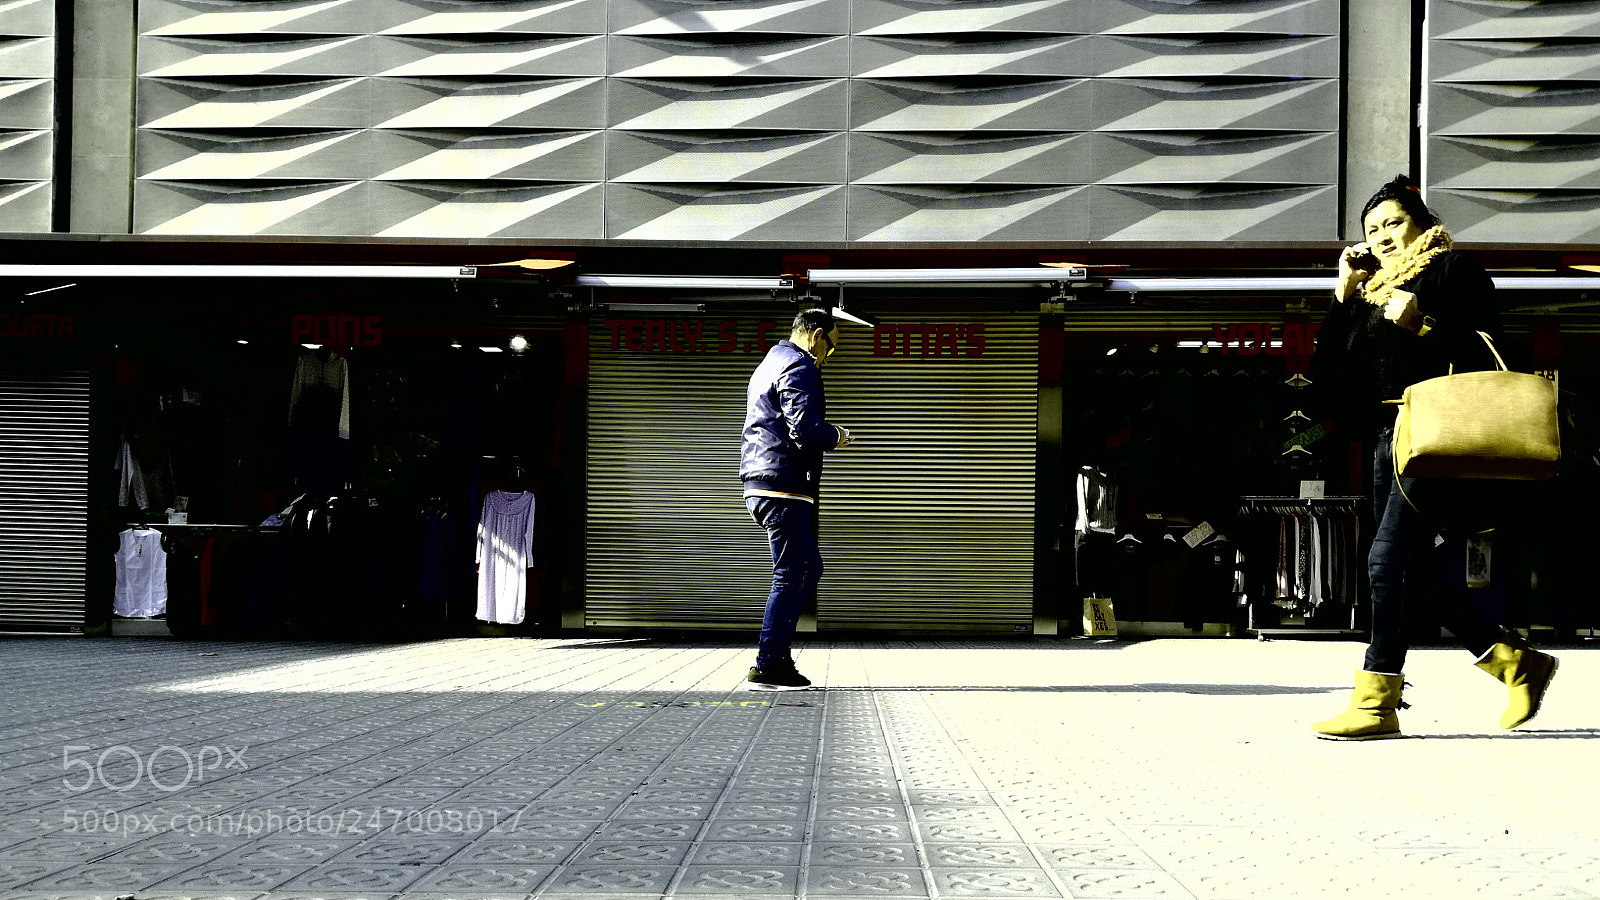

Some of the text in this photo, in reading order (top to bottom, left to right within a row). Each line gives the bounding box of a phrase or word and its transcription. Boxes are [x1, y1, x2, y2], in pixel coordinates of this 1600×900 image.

[291, 312, 382, 346] PONS
[605, 319, 706, 356] TERLY,
[873, 324, 986, 356] OTTA'S
